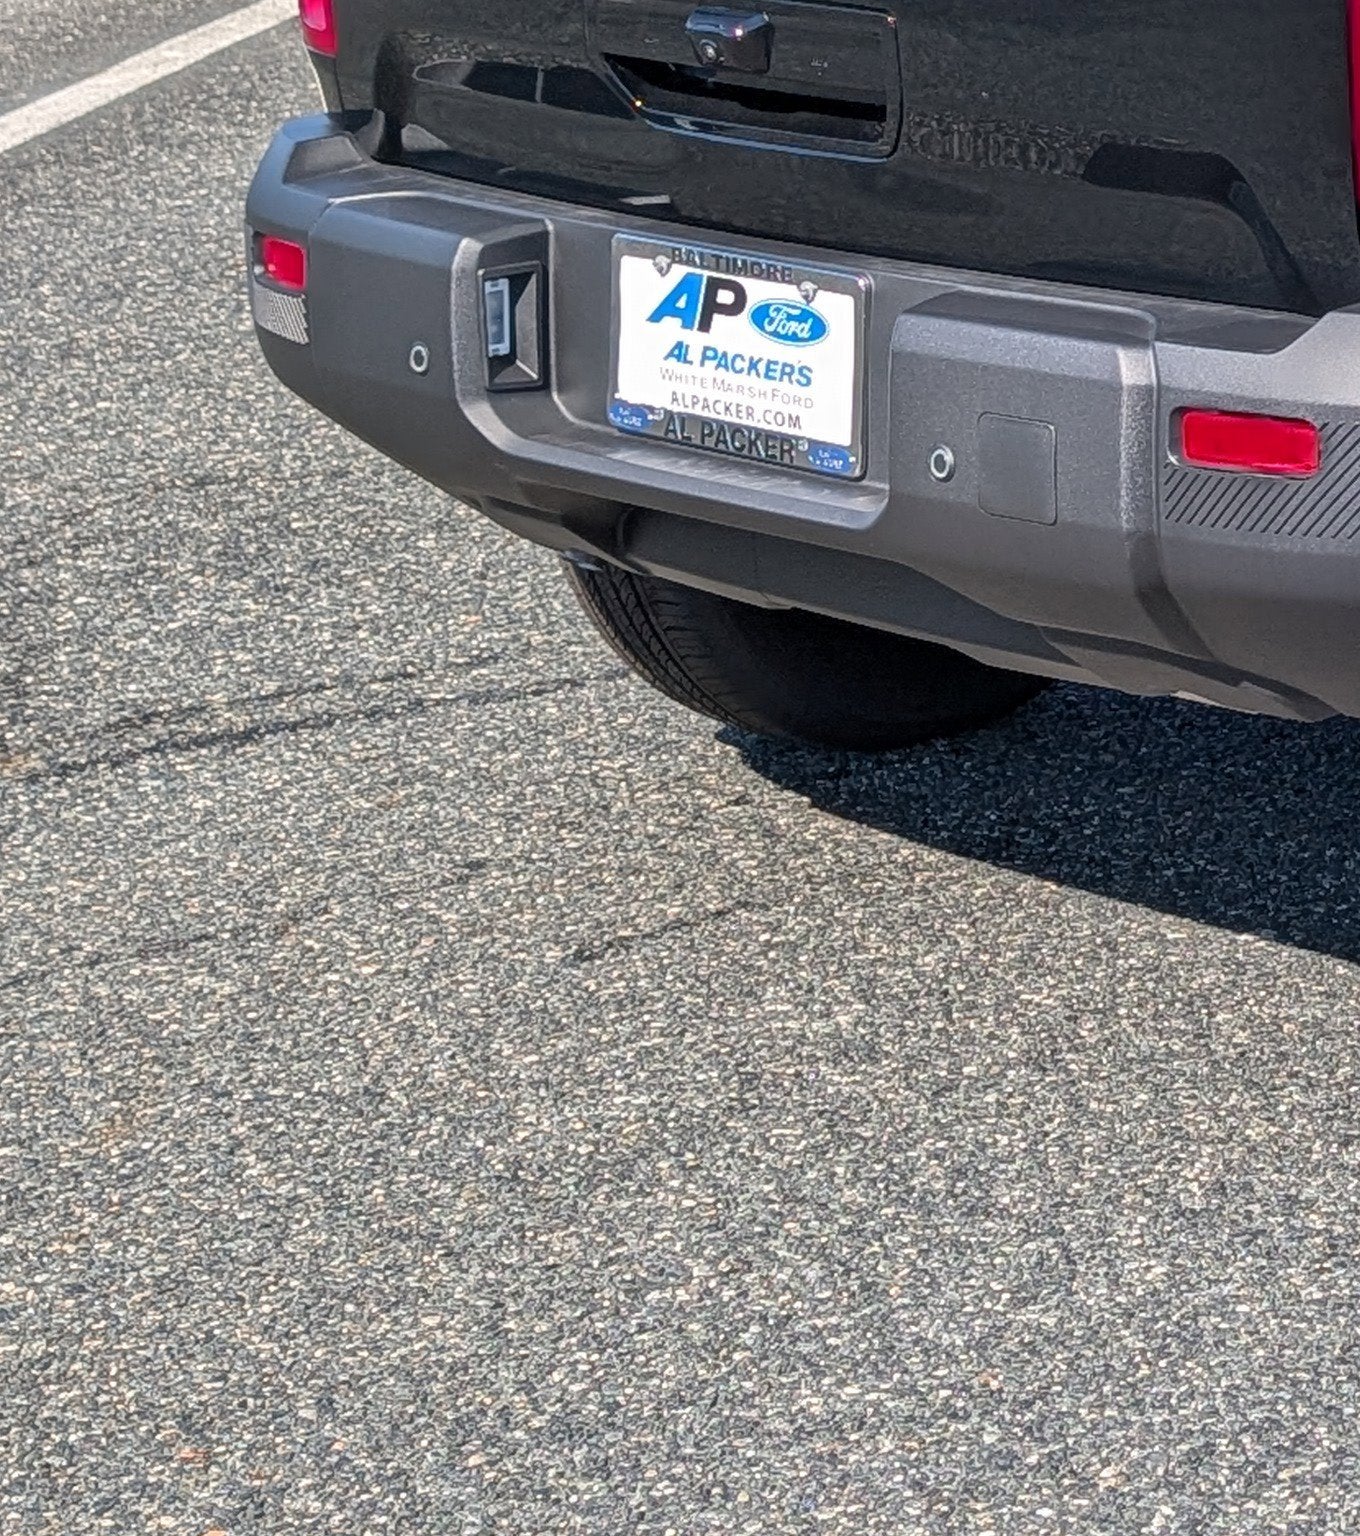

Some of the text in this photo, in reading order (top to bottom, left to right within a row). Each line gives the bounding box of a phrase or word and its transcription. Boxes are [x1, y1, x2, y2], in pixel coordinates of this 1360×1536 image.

[671, 247, 794, 283] BALTIMORE
[645, 271, 814, 339] AP Ford
[663, 340, 814, 387] AL PACKER'S
[659, 366, 814, 409] WHITE MARSH FORD
[670, 390, 802, 430] ALPACKER.COM
[663, 414, 693, 442] AL
[701, 420, 795, 464] PACKER
